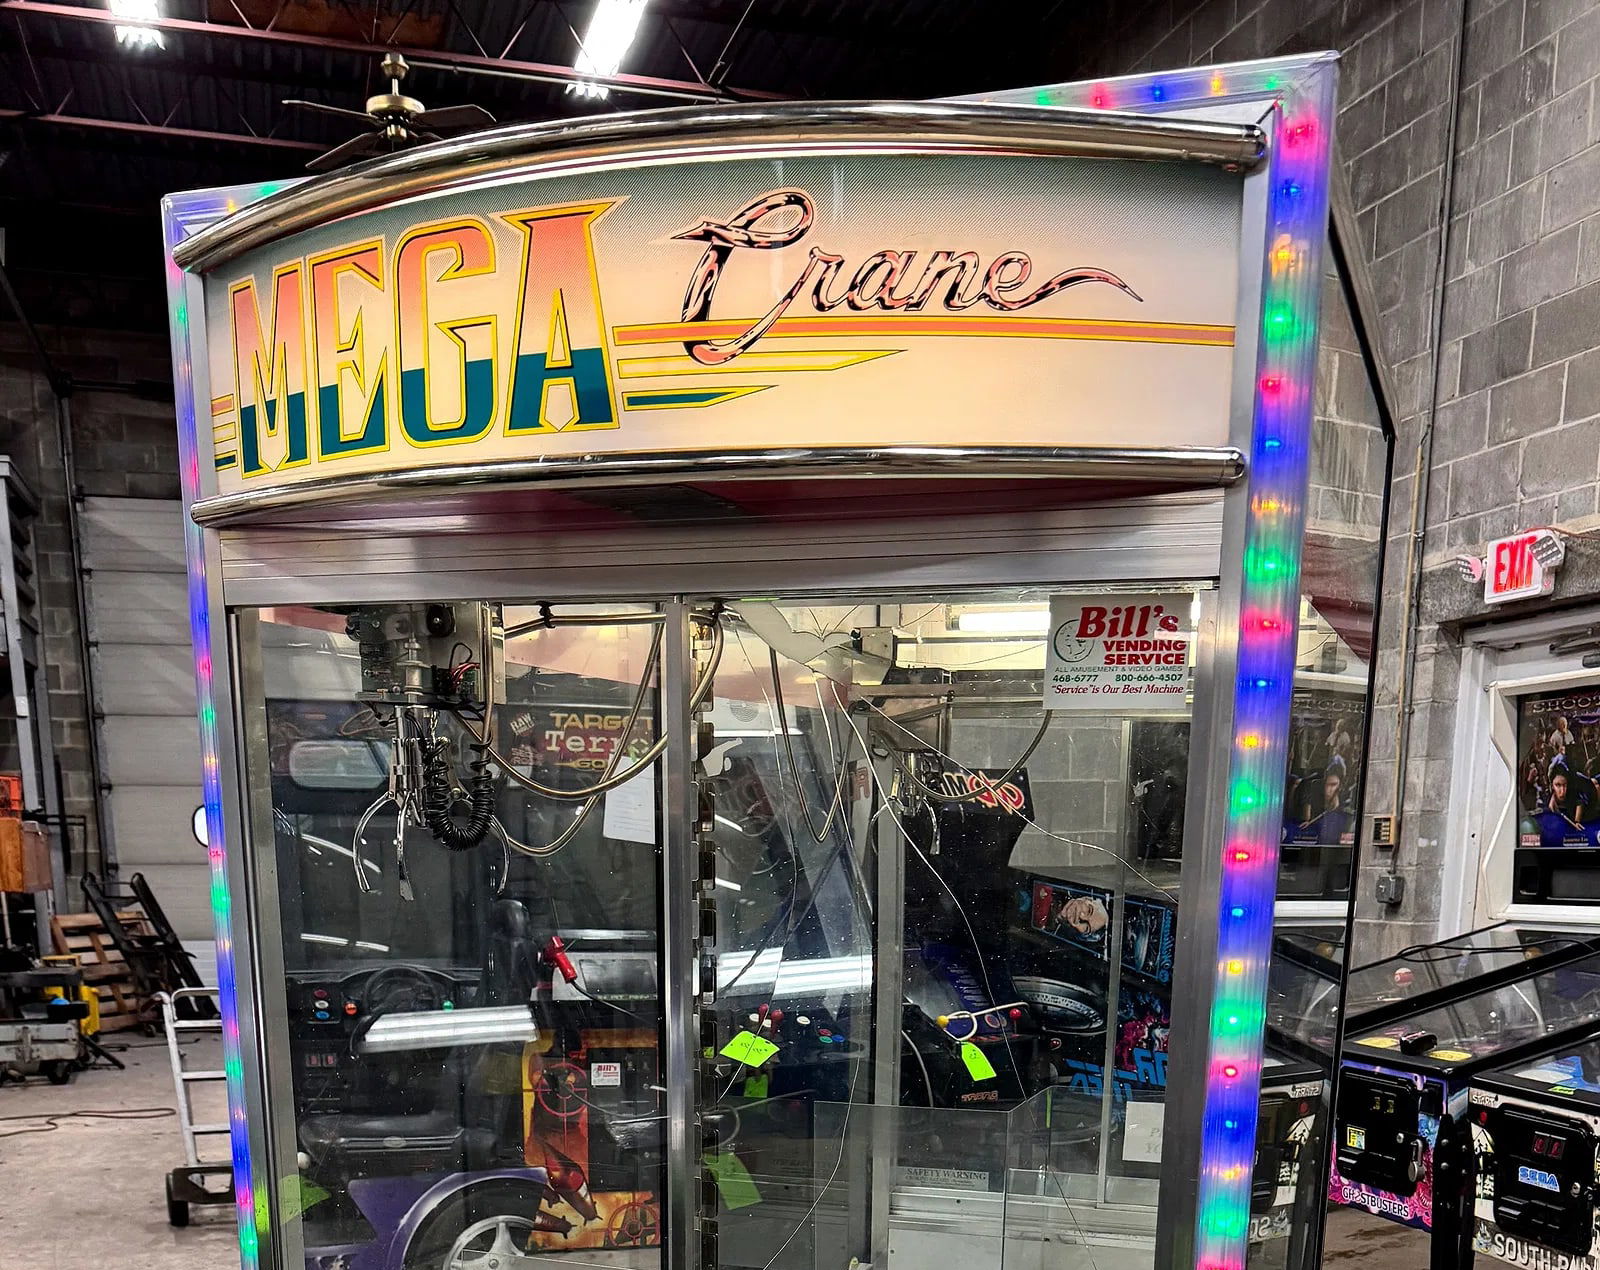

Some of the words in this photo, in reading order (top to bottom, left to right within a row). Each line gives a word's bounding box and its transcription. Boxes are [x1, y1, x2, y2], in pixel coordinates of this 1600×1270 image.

[229, 195, 631, 479] MEGA
[669, 187, 1143, 365] Crane
[1493, 536, 1537, 594] EXIT
[1075, 605, 1179, 638] Bill's
[1103, 640, 1187, 652] VENDING
[1104, 653, 1185, 665] SERVICE
[1052, 674, 1098, 683] 468-6777
[1102, 684, 1120, 694] Our
[1122, 684, 1142, 694] Best
[1144, 684, 1183, 694] Machine
[907, 1167, 940, 1177] SAFETY
[943, 1170, 986, 1181] WARNING
[1519, 1167, 1558, 1188] SEGA
